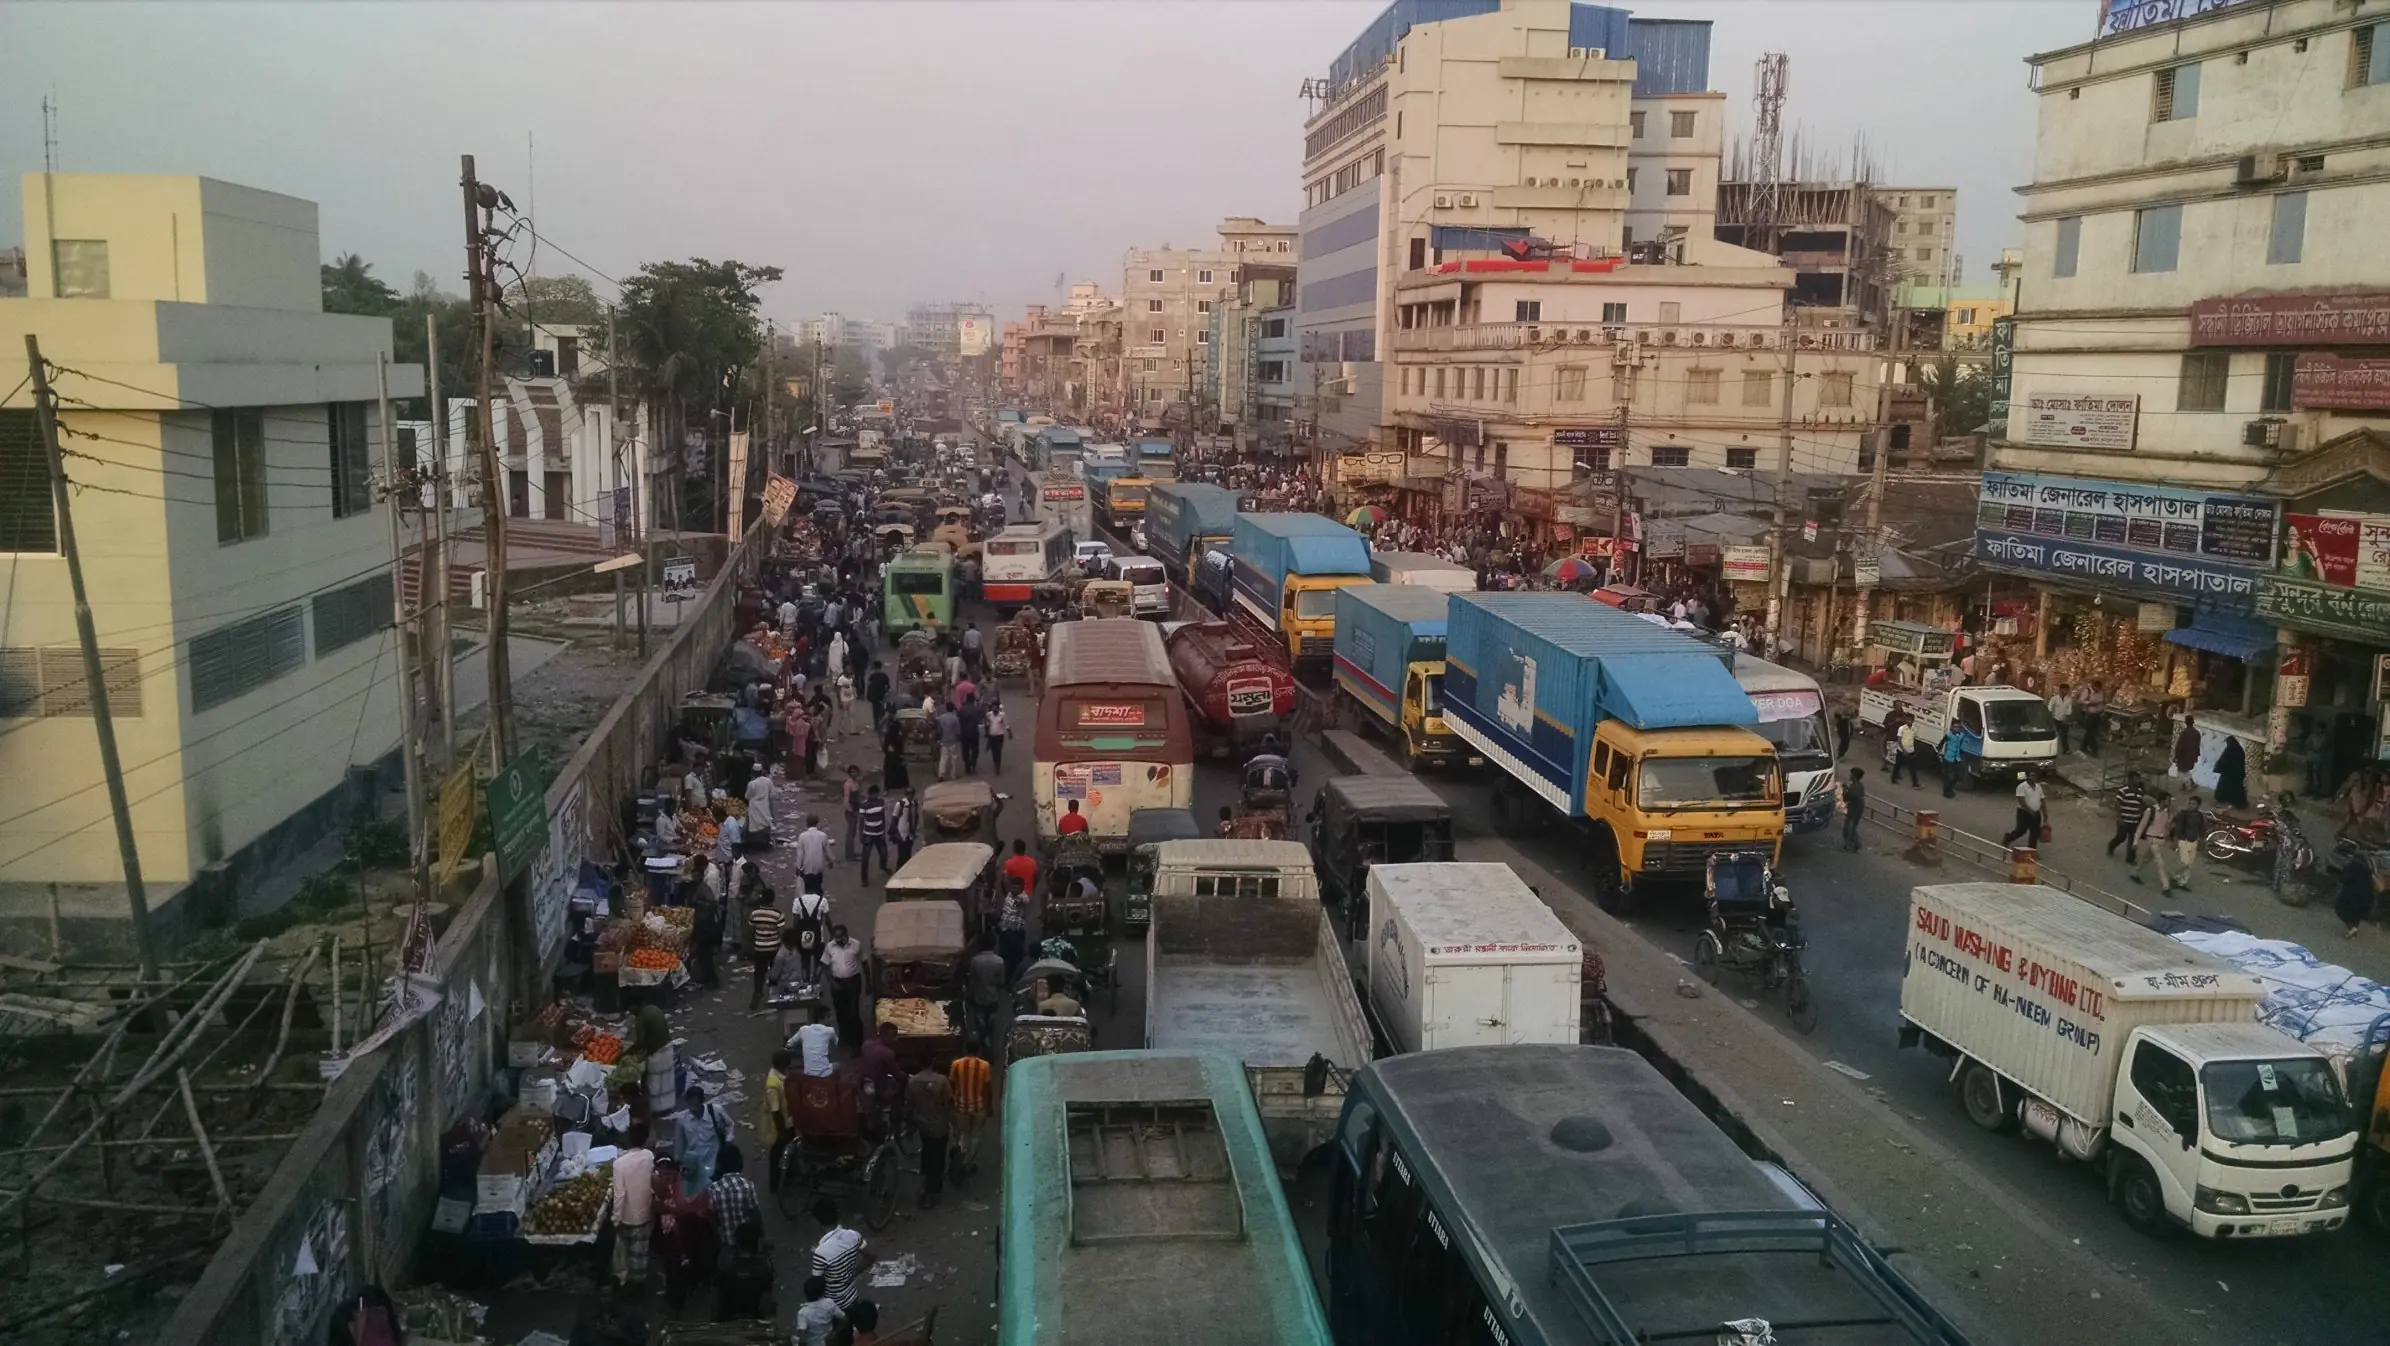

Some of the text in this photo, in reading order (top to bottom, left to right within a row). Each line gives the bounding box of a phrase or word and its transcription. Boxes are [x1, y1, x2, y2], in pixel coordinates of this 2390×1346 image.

[1985, 476, 2205, 520] ফাতিমা জেনারেল হাসপাতাল
[1984, 536, 2254, 595] ফাতিমা জেনারেল হাসপাতাল
[1778, 697, 1803, 709] DOA
[1954, 925, 2013, 973] WASHING
[2018, 957, 2028, 981] &
[2079, 985, 2105, 1022] LTD.
[1975, 974, 1990, 995] OF
[1392, 1151, 1411, 1187] UTTARA
[1427, 1210, 1449, 1251] UTTARA
[1483, 1305, 1509, 1346] UTTARA
